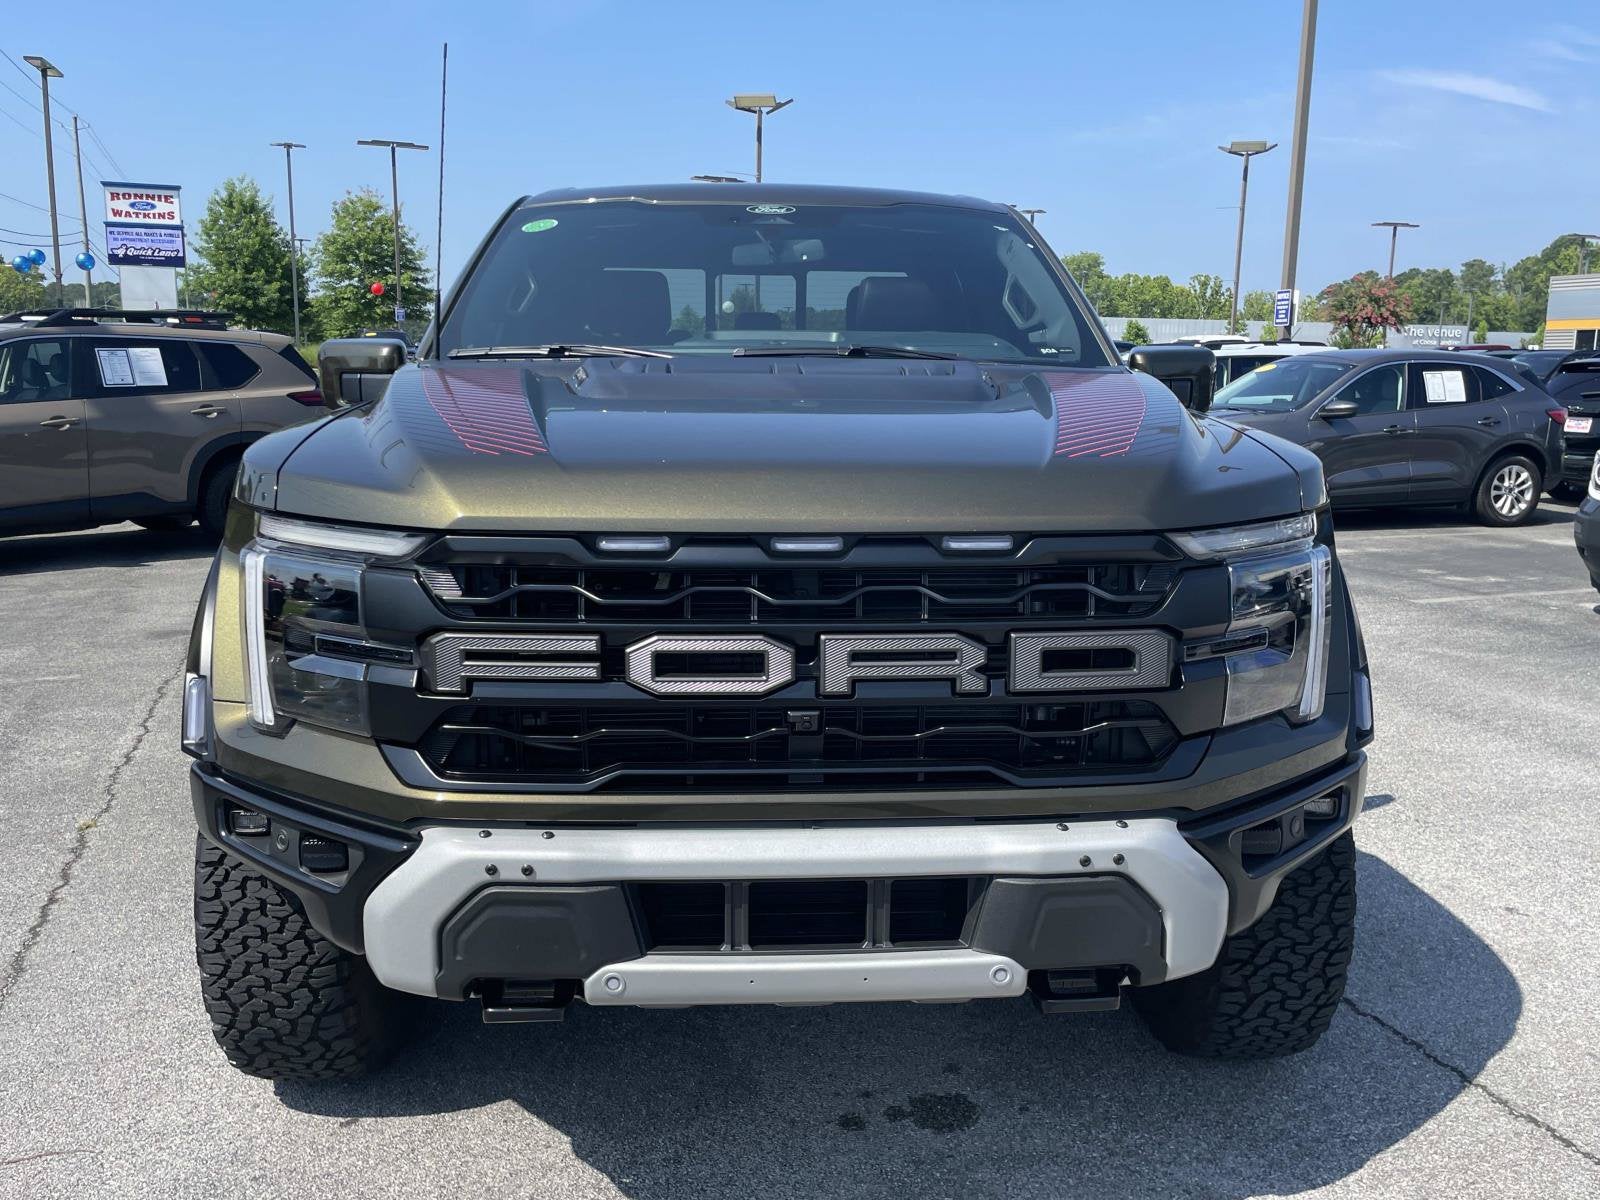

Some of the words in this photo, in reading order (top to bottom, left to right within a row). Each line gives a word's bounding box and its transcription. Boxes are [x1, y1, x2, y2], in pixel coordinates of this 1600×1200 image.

[110, 192, 174, 205] RONNIE
[111, 208, 175, 220] WATKINS
[127, 248, 153, 256] Quick
[154, 249, 178, 257] Lane
[424, 631, 1174, 696] FORD
